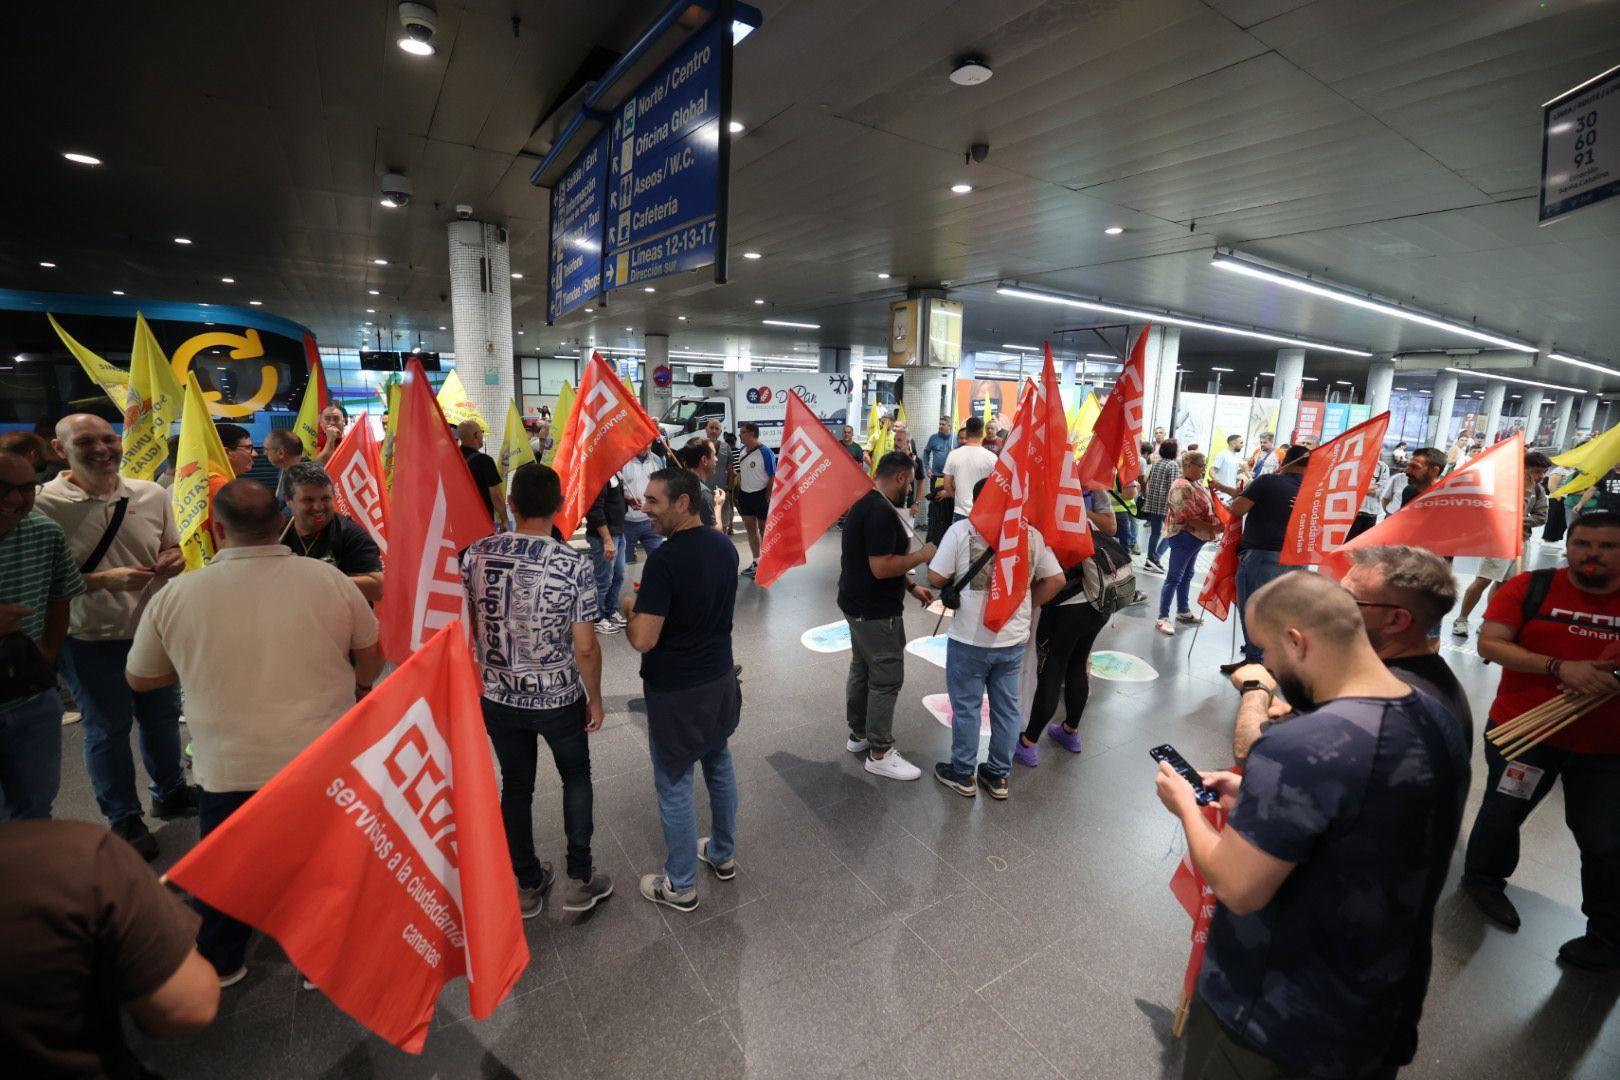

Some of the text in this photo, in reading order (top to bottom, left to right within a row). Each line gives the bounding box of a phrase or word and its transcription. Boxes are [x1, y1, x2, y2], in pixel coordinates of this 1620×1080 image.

[638, 85, 664, 117] Norte
[671, 46, 711, 89] Centro
[636, 89, 708, 156] Oficina Global
[1574, 130, 1596, 151] 60
[1576, 111, 1598, 134] 30
[634, 168, 662, 197] Aseos
[670, 147, 695, 176] W.C.
[1574, 149, 1594, 169] 91
[632, 195, 678, 231] Cafetería
[632, 220, 716, 267] Líneas 12-13-17
[630, 260, 677, 282] Dirección sur
[1296, 513, 1307, 554] canarias
[1308, 500, 1321, 552] ciudadanía
[326, 777, 467, 948] servicios a la ciudadanía
[402, 922, 442, 970] canarias
